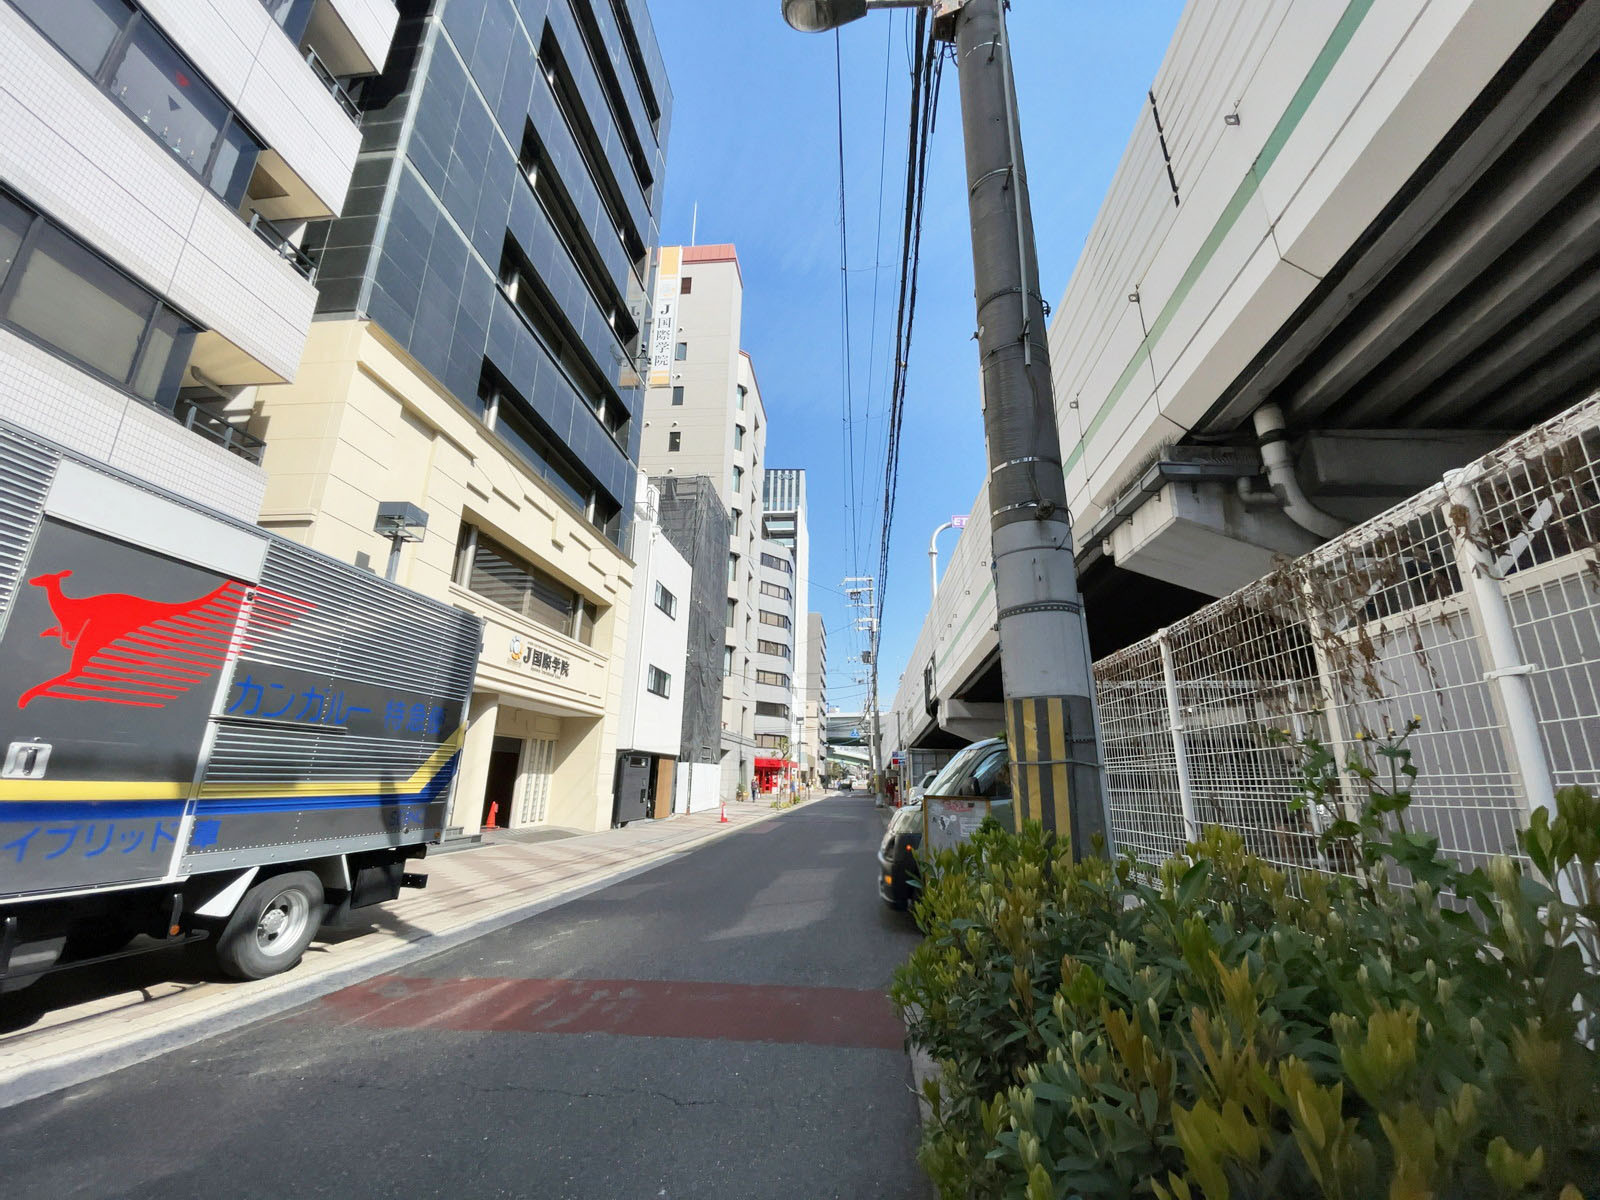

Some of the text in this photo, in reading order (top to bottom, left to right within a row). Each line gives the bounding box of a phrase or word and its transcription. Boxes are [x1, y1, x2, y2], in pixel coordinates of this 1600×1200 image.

[655, 304, 672, 366] J国際学院
[953, 517, 969, 526] ET
[522, 646, 570, 678] J国際学院
[228, 674, 372, 725] カンガルー
